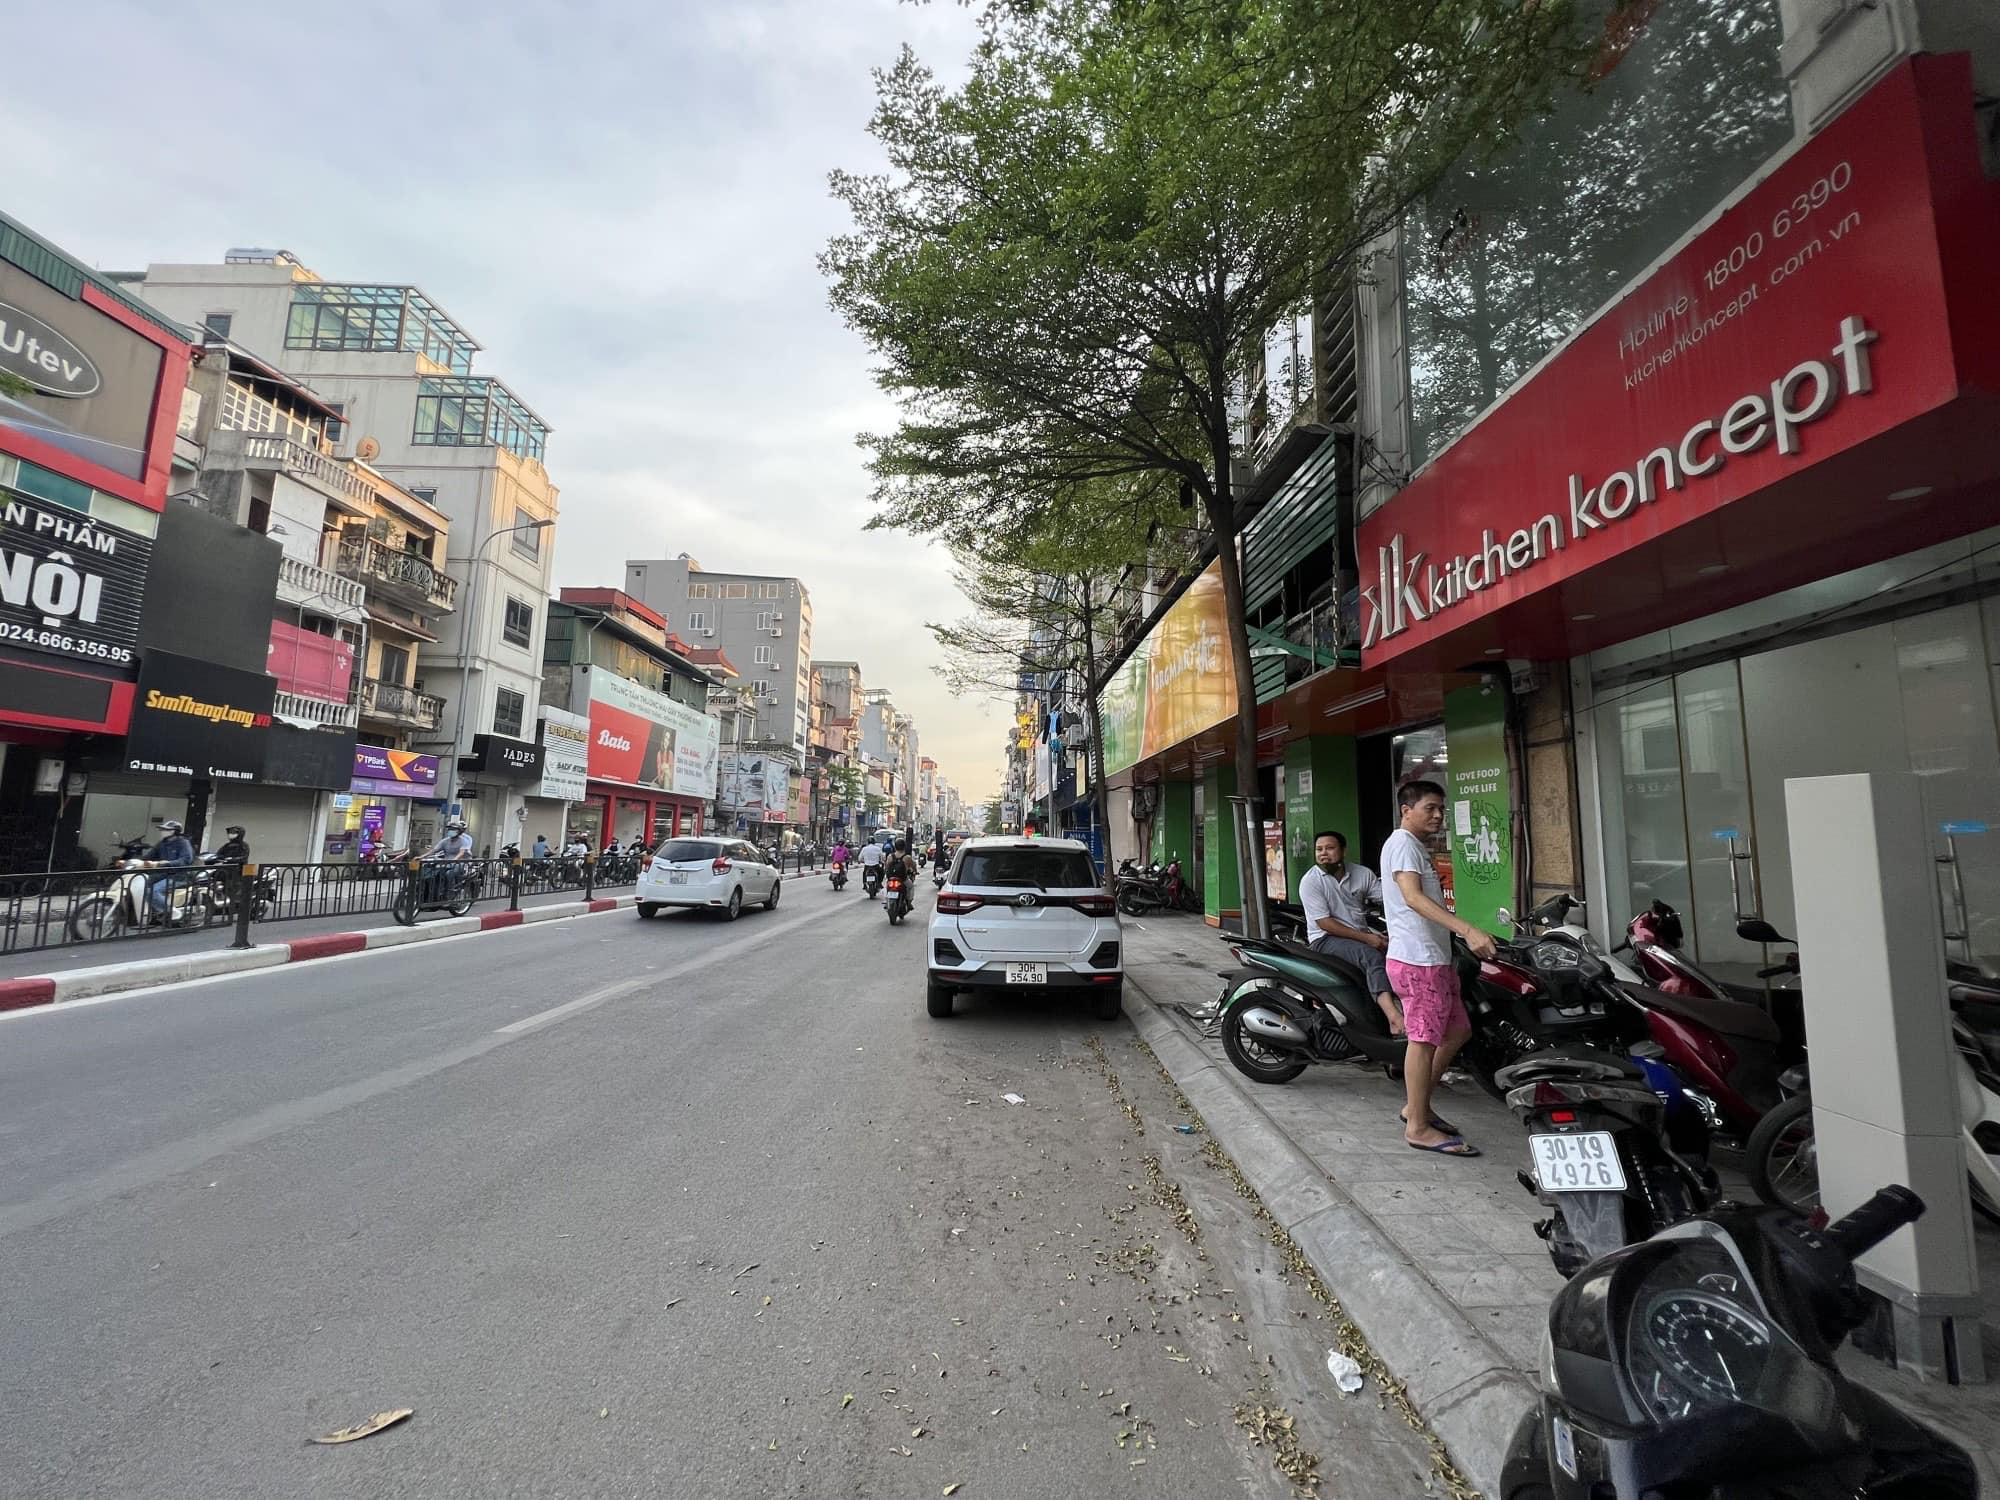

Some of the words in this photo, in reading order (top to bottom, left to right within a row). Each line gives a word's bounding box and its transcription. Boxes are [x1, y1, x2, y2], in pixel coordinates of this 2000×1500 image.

[1703, 232, 1764, 292] 1800
[1772, 161, 1851, 239] 6390
[1428, 514, 1566, 614] kitchen
[1568, 314, 1879, 540] koncept
[35, 518, 116, 555] PHẨM
[0, 622, 132, 662] 024.666.355.95
[597, 729, 631, 752] Bata
[364, 755, 386, 766] TPBank
[503, 747, 536, 764] JADES
[1455, 771, 1476, 781] LOVE
[1477, 768, 1501, 778] FOOD
[1459, 784, 1480, 794] LOVE
[1481, 782, 1497, 793] LIFE
[1010, 973, 1043, 983] 554.90
[1017, 963, 1036, 973] 30H
[1542, 1136, 1605, 1161] 30-K9
[1551, 1162, 1612, 1186] 4926
